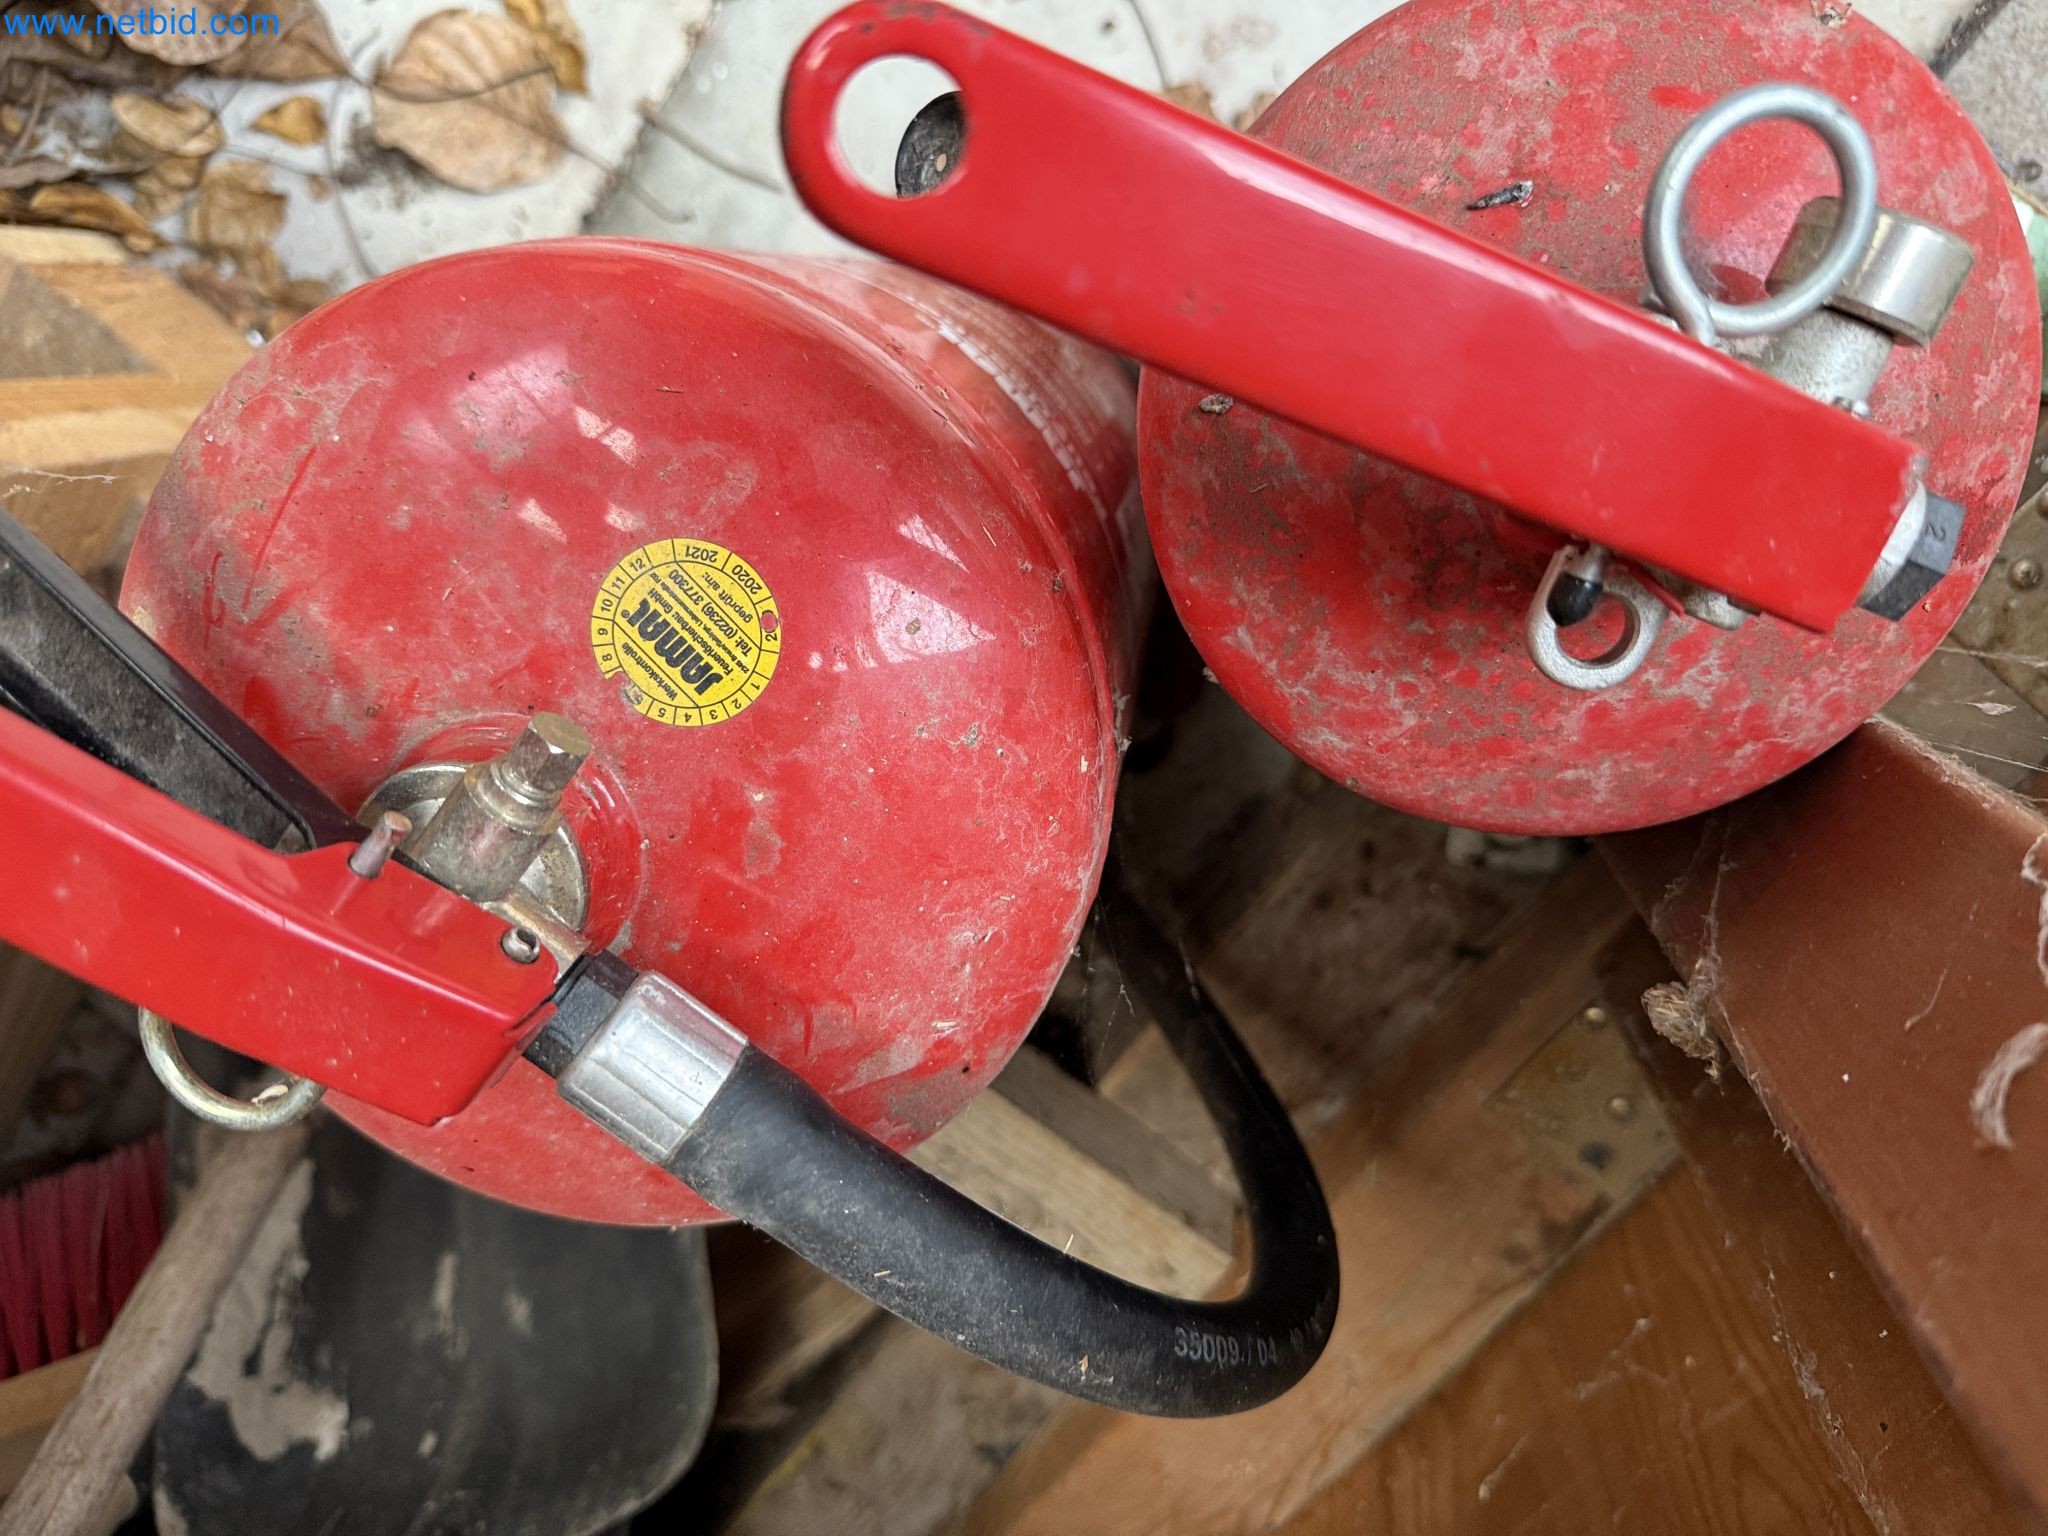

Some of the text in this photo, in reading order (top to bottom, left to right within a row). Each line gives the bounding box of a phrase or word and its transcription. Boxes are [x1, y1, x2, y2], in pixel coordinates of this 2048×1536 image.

[685, 545, 719, 563] 2021
[629, 557, 646, 572] 12
[611, 576, 626, 590] 11
[731, 564, 763, 595] 2020
[647, 587, 674, 614] GmbH
[701, 571, 754, 624] geprüft am:
[600, 599, 613, 612] 10
[668, 569, 753, 657] Tel: (02236) 377300
[597, 627, 608, 636] 9
[626, 598, 725, 697] JAMAL
[602, 653, 613, 662] 8
[621, 641, 678, 702] Werkskontrolle
[750, 682, 761, 691] 1
[731, 697, 742, 710] 2
[657, 707, 667, 718] 5
[683, 712, 692, 722] 4
[709, 709, 718, 719] 3
